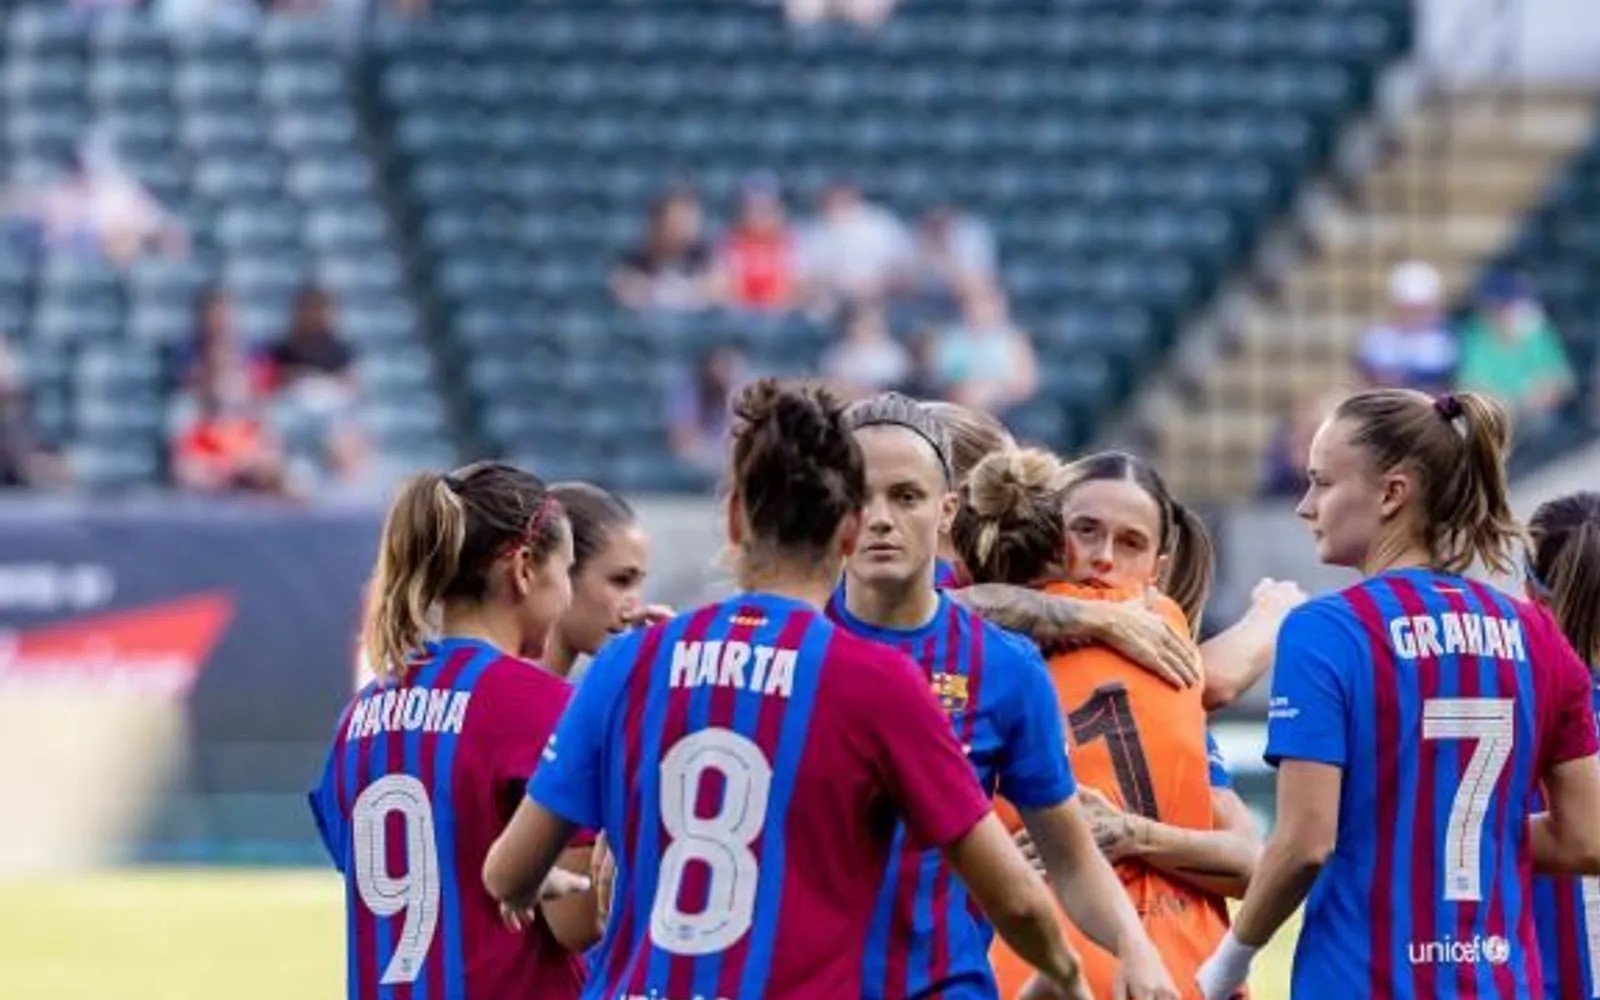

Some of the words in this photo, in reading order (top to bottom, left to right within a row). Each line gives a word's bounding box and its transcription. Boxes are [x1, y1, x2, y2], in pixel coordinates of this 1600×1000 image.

[669, 640, 799, 698] MARTA
[1390, 612, 1527, 663] GRAHAM
[1068, 681, 1160, 824] 1
[1422, 697, 1516, 902] 7
[351, 772, 442, 985] 9
[650, 726, 774, 956] 8
[1408, 935, 1482, 964] unicef
